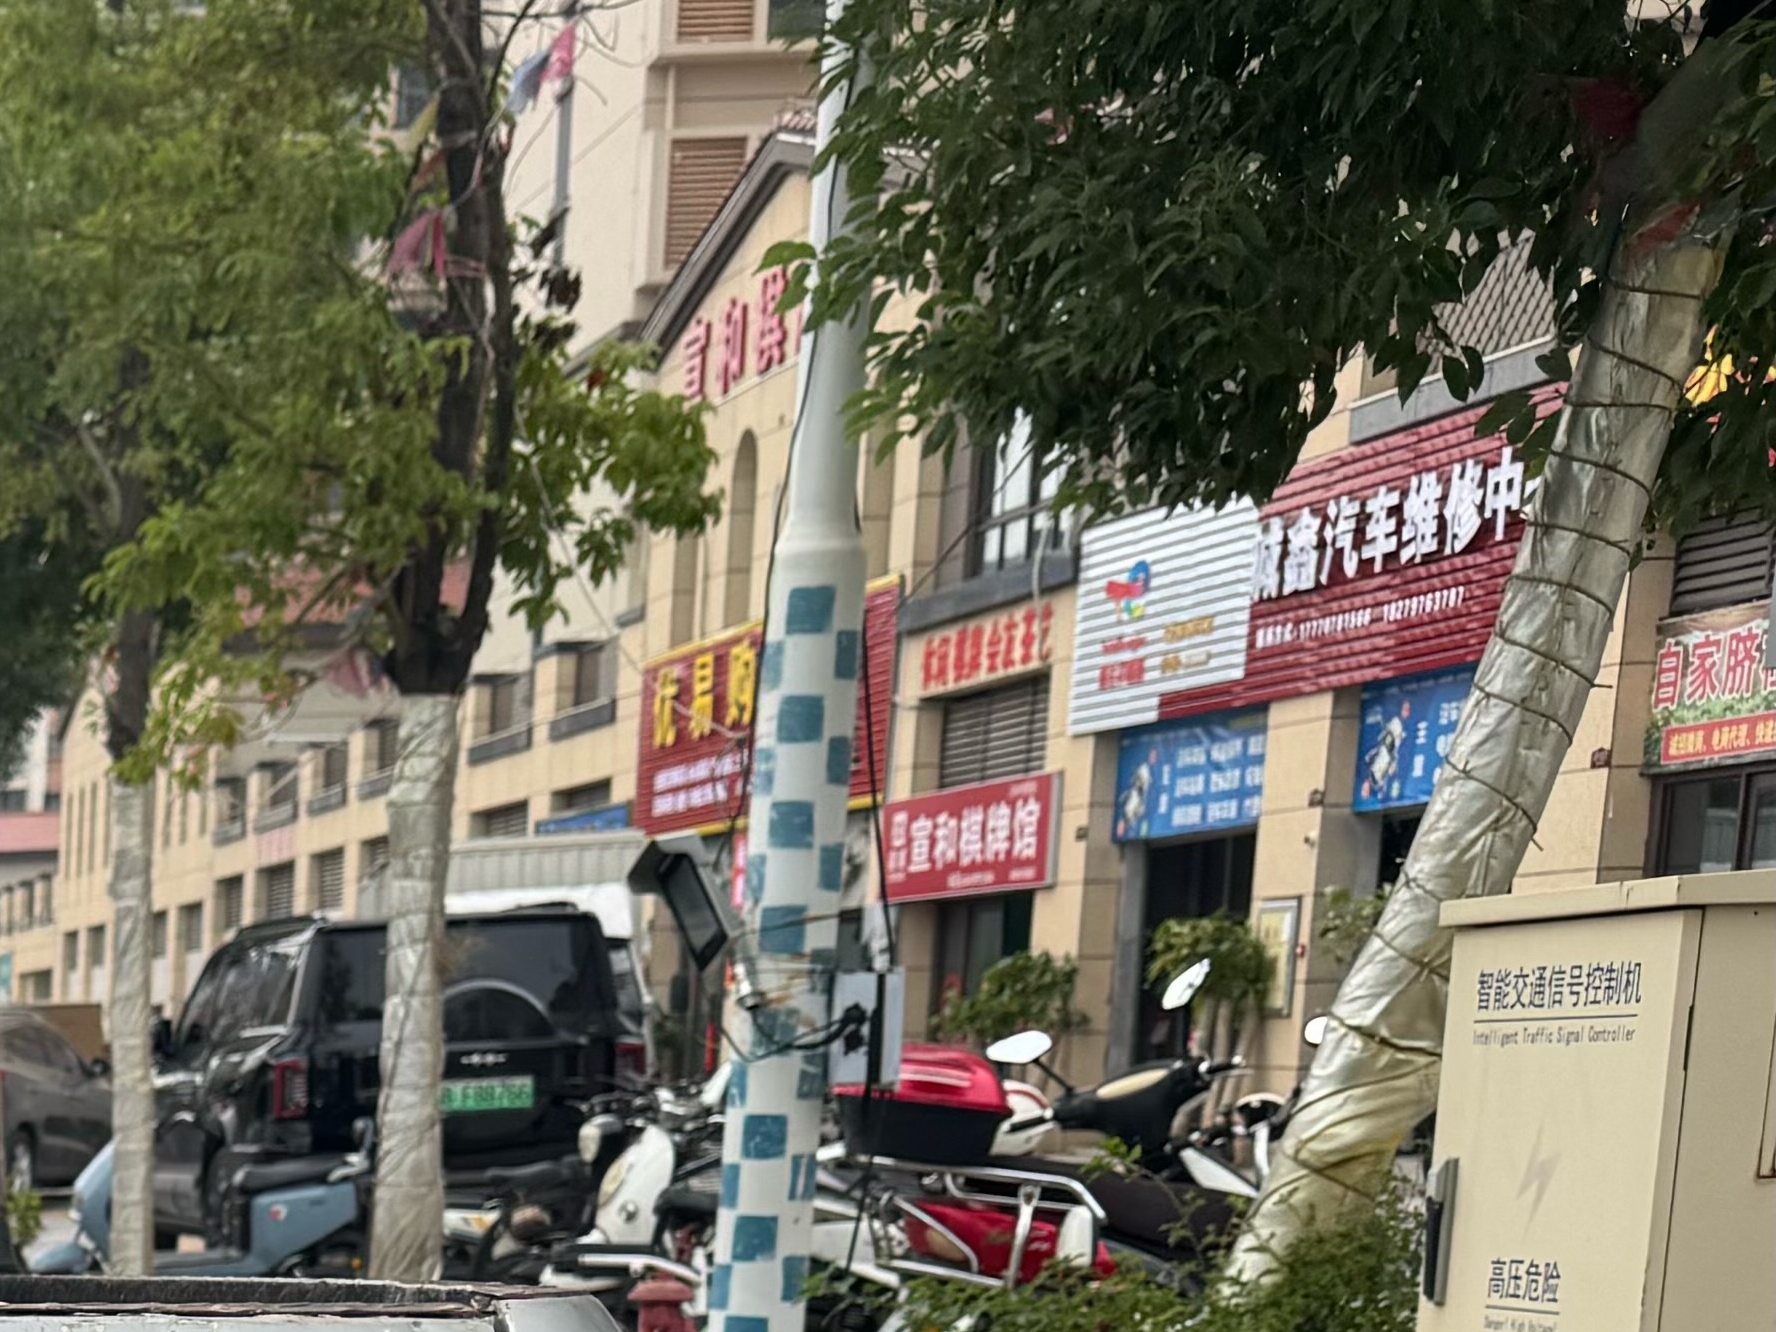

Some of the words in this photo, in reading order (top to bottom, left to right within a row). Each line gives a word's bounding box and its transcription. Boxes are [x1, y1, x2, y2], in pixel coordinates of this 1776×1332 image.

[681, 264, 803, 413] 宣和棋
[907, 795, 1042, 875] 宣和棋牌馆
[1477, 960, 1642, 1012] 智能交通信号控制机
[1473, 1029, 1518, 1047] Intelligent
[1522, 1026, 1553, 1045] Traffic
[1556, 1025, 1584, 1046] Signal
[1588, 1025, 1636, 1043] Controller
[1487, 1257, 1561, 1303] 高压危险
